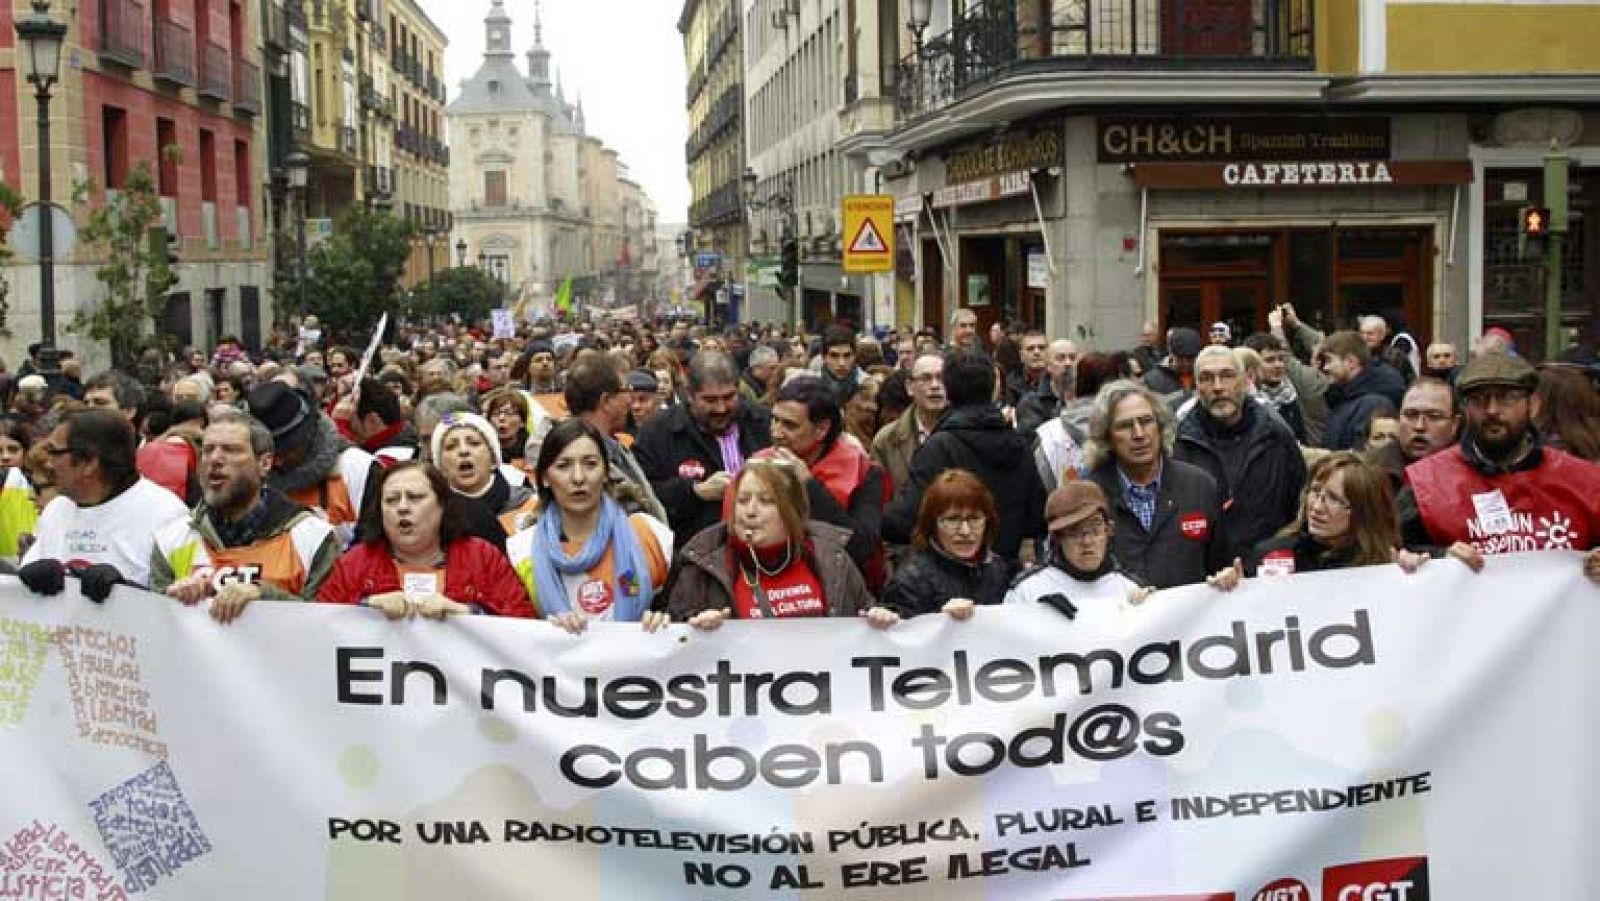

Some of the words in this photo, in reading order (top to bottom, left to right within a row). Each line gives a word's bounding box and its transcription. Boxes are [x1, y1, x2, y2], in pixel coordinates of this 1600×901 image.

[1103, 124, 1232, 154] CH&CH
[1223, 162, 1392, 185] CAFETERIA
[335, 646, 448, 706] En
[480, 659, 832, 719] nuestra
[850, 609, 1376, 711] Telemadrid
[559, 733, 885, 792] caben
[912, 703, 1185, 780] tod@s
[328, 816, 402, 844] POR
[416, 820, 490, 845] UNA
[503, 817, 814, 854] RADIOTELEVISIÓN
[827, 819, 980, 852] PÚBLICA,
[994, 803, 1124, 837] PLURAL
[1135, 800, 1157, 822] E
[1171, 771, 1432, 821] INDEPENDIENTE
[683, 862, 752, 889] NO
[768, 864, 824, 890] AL
[840, 854, 928, 889] ERE
[946, 843, 1091, 879] ILEGAL
[1336, 880, 1415, 901] CGT
